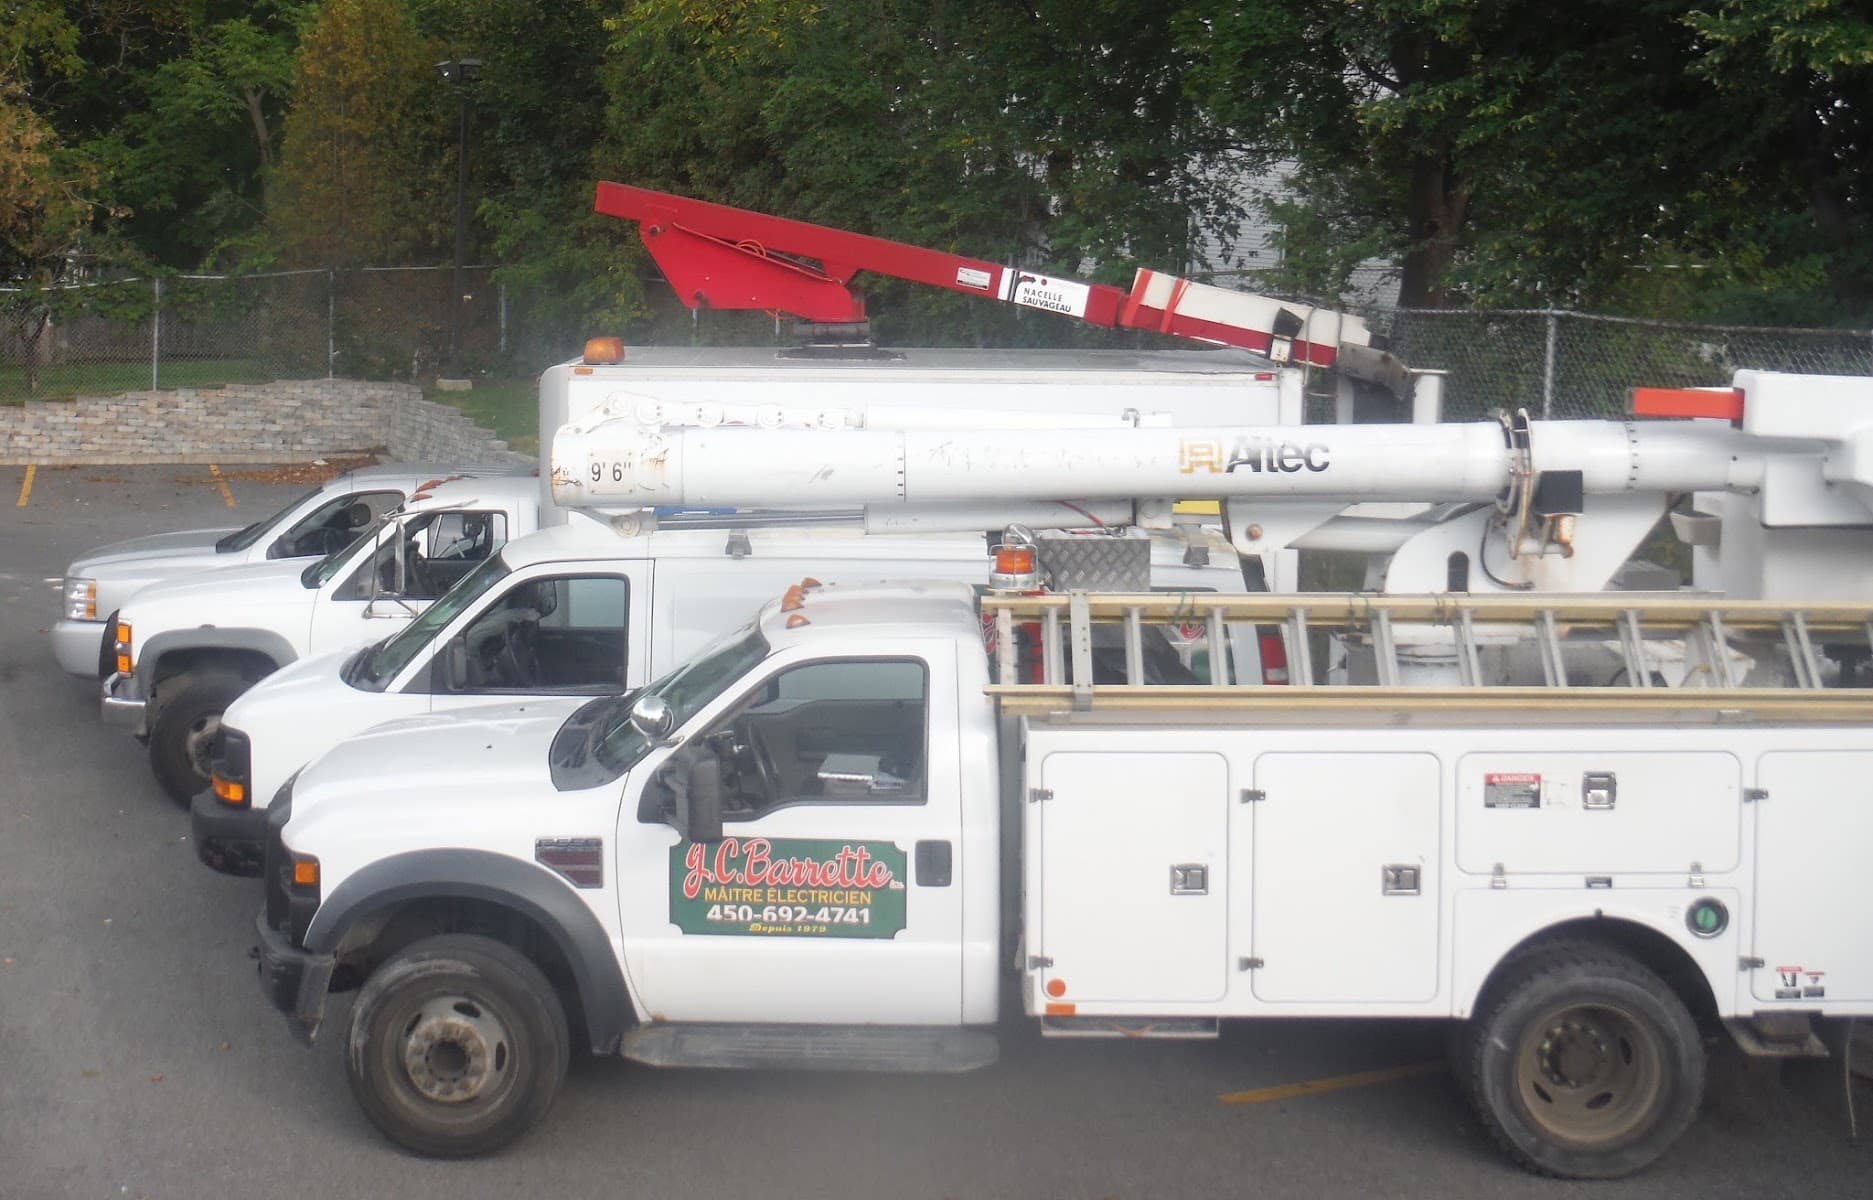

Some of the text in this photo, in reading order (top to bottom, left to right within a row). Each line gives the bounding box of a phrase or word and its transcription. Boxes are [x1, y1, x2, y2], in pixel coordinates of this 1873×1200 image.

[1023, 287, 1063, 302] NACELLE
[1022, 296, 1072, 313] SAUVAGEAU
[1225, 435, 1330, 473] Altec
[706, 904, 870, 925] 450-692-4741
[749, 922, 827, 934] Depuis 1979
